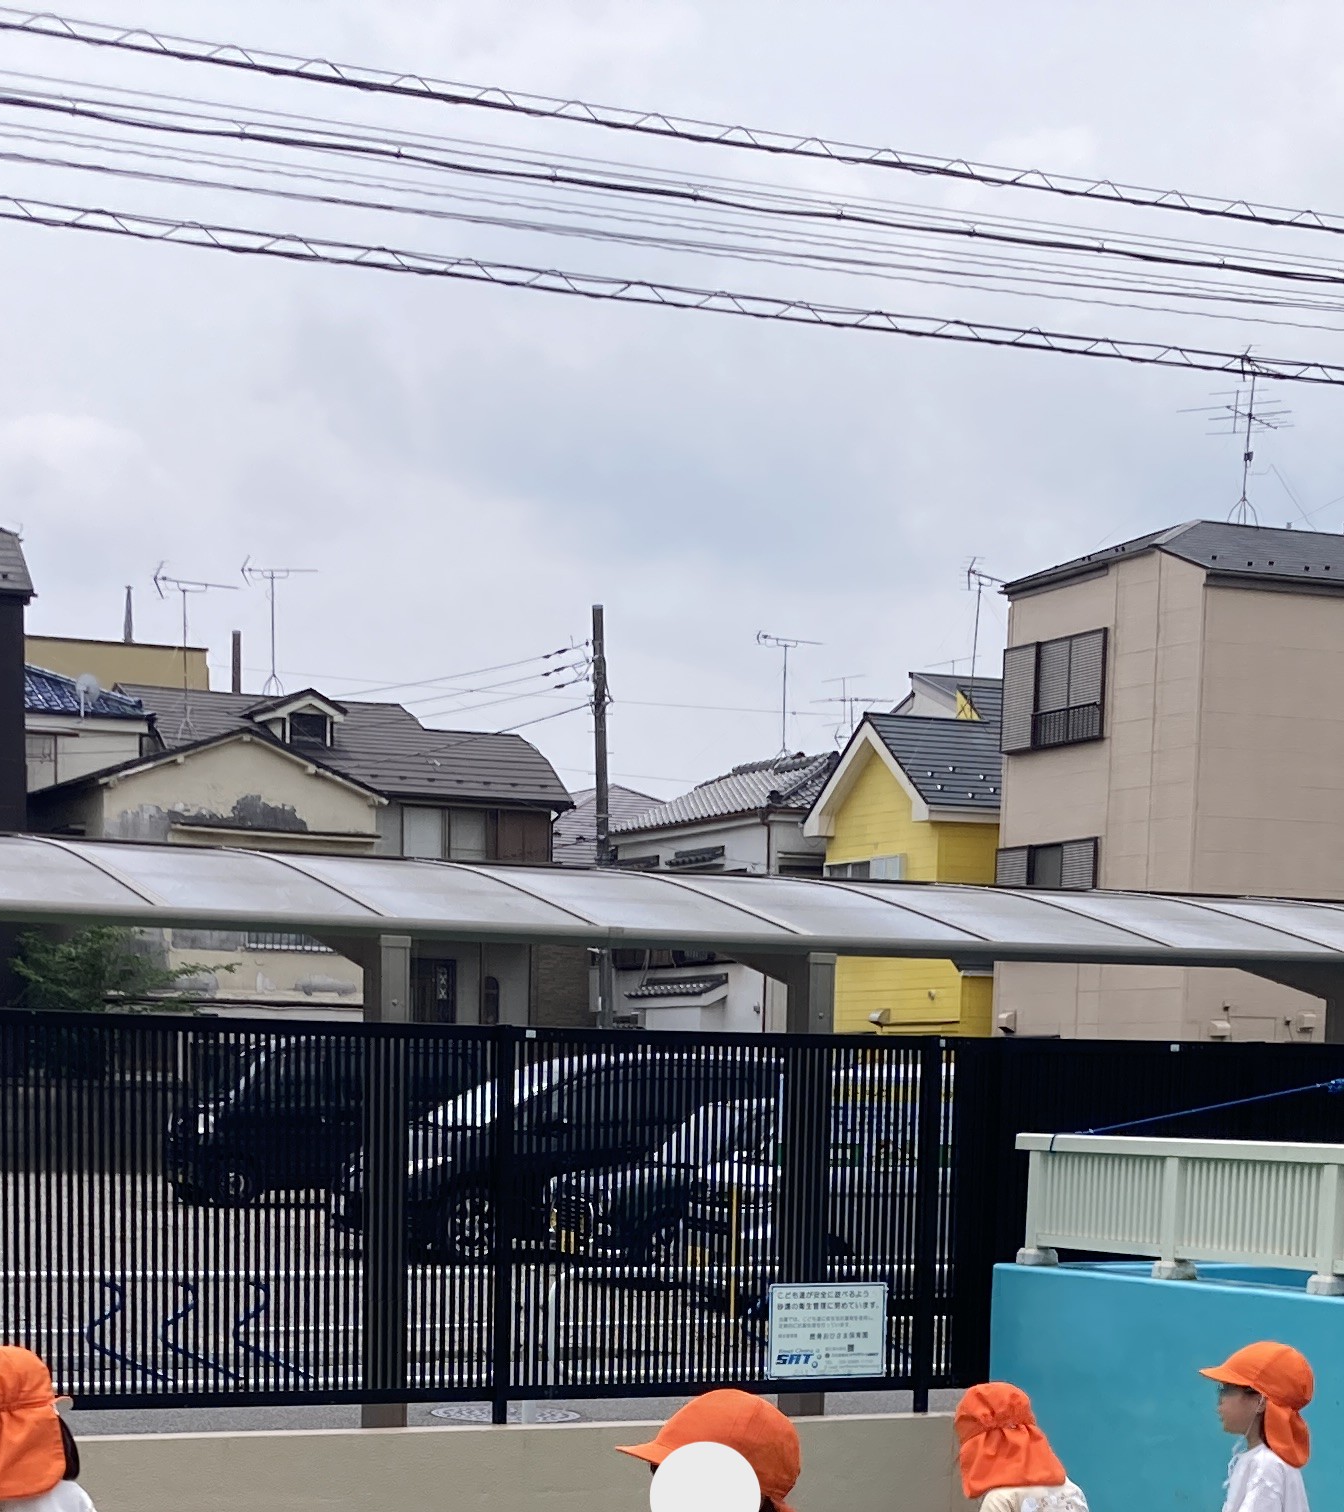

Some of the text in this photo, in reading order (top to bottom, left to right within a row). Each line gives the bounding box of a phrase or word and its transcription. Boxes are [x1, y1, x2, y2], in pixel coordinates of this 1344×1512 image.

[777, 1291, 869, 1299] こども達が安全に遊べるよう
